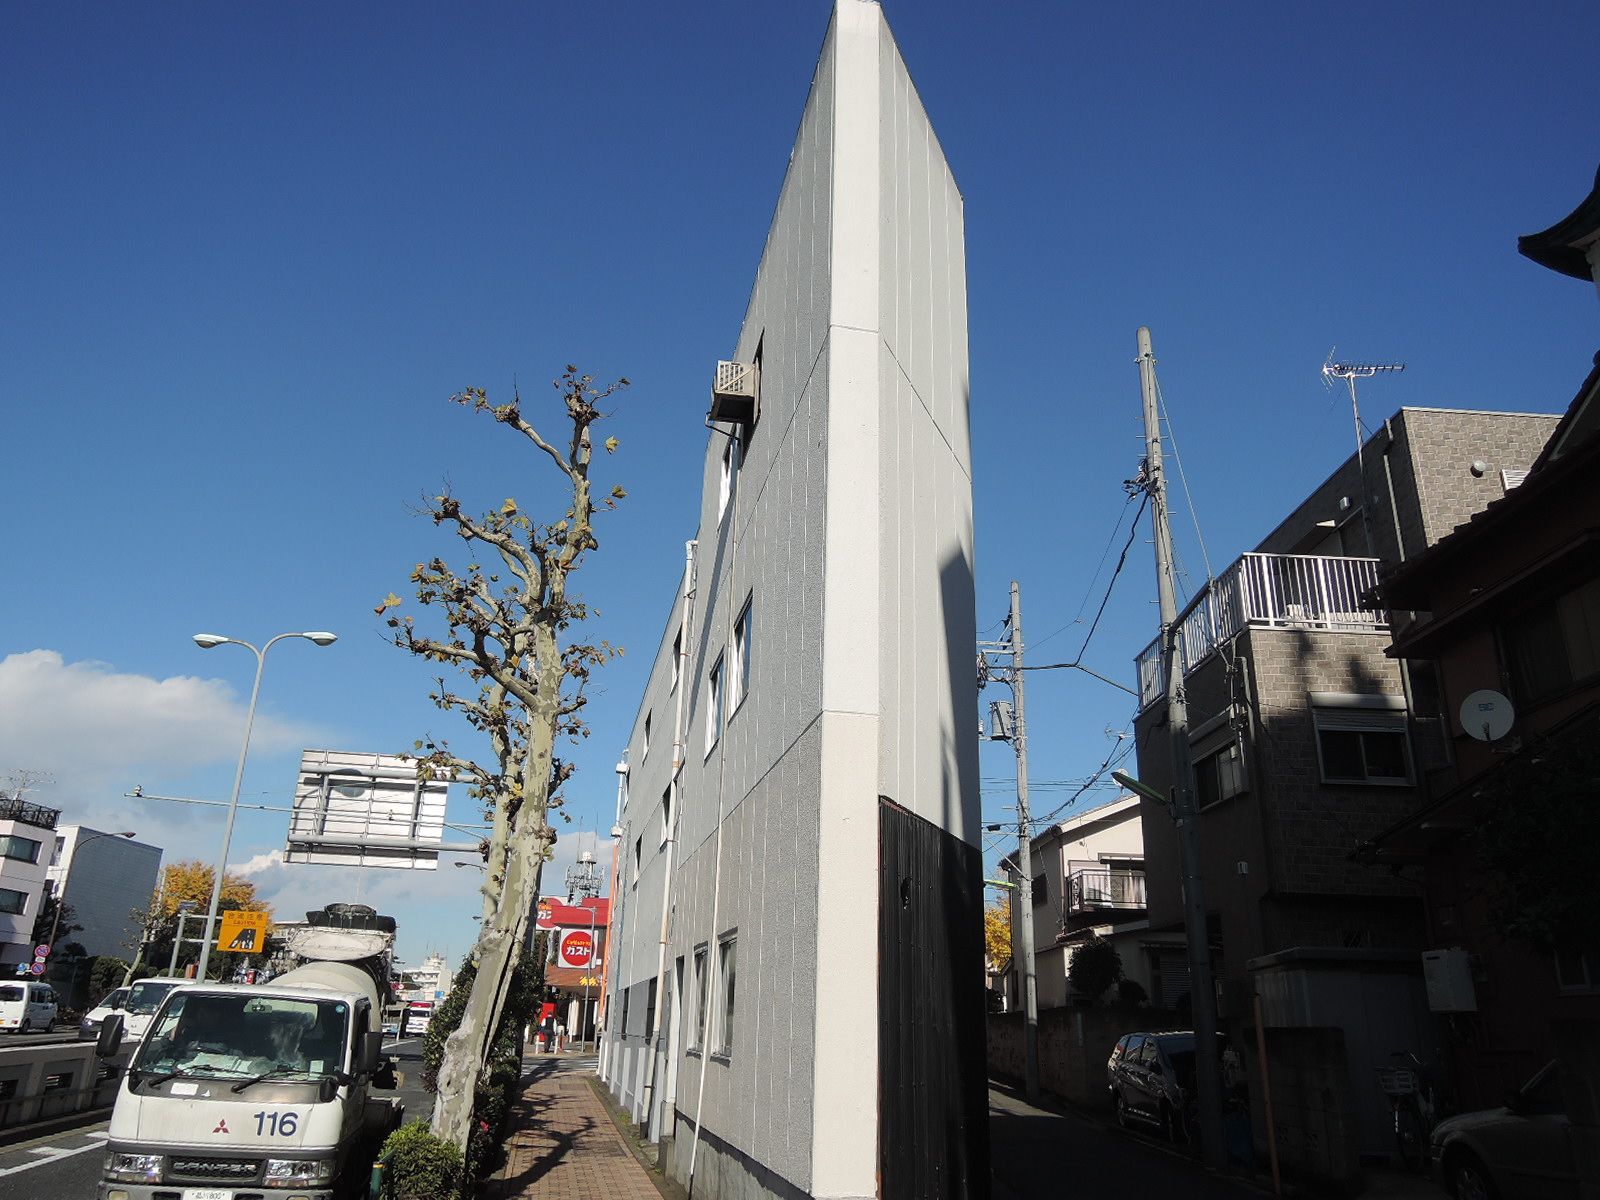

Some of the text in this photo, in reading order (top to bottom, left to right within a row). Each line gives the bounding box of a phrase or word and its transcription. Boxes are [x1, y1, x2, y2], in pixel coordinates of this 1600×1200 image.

[566, 945, 591, 956] ガスト
[254, 1111, 299, 1137] 116
[173, 1162, 257, 1173] CANTER
